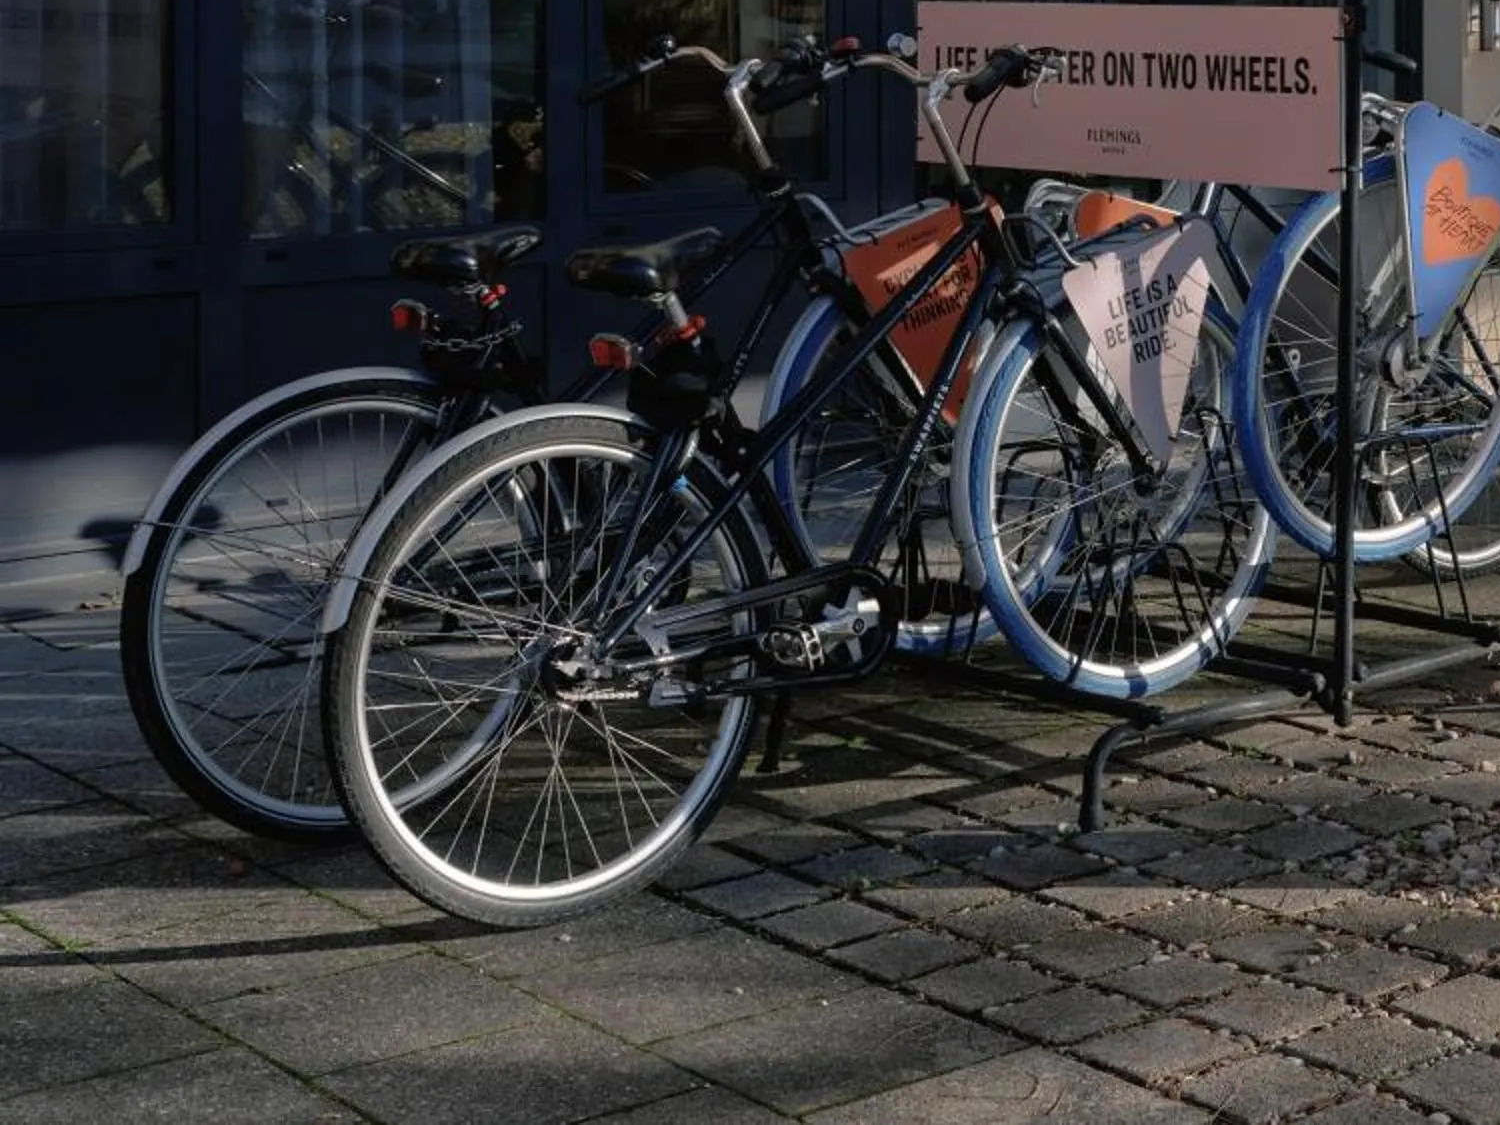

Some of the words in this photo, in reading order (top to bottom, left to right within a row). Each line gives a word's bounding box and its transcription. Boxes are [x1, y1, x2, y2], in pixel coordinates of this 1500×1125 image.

[1103, 51, 1136, 87] ON
[1142, 52, 1197, 90] TWO
[1205, 56, 1318, 96] WHEELS.
[1108, 287, 1143, 320] LIFE
[1145, 279, 1163, 304] IS
[1167, 273, 1178, 296] A
[1104, 294, 1194, 350] BEAUTIFUL
[1132, 329, 1177, 364] RIDE.
